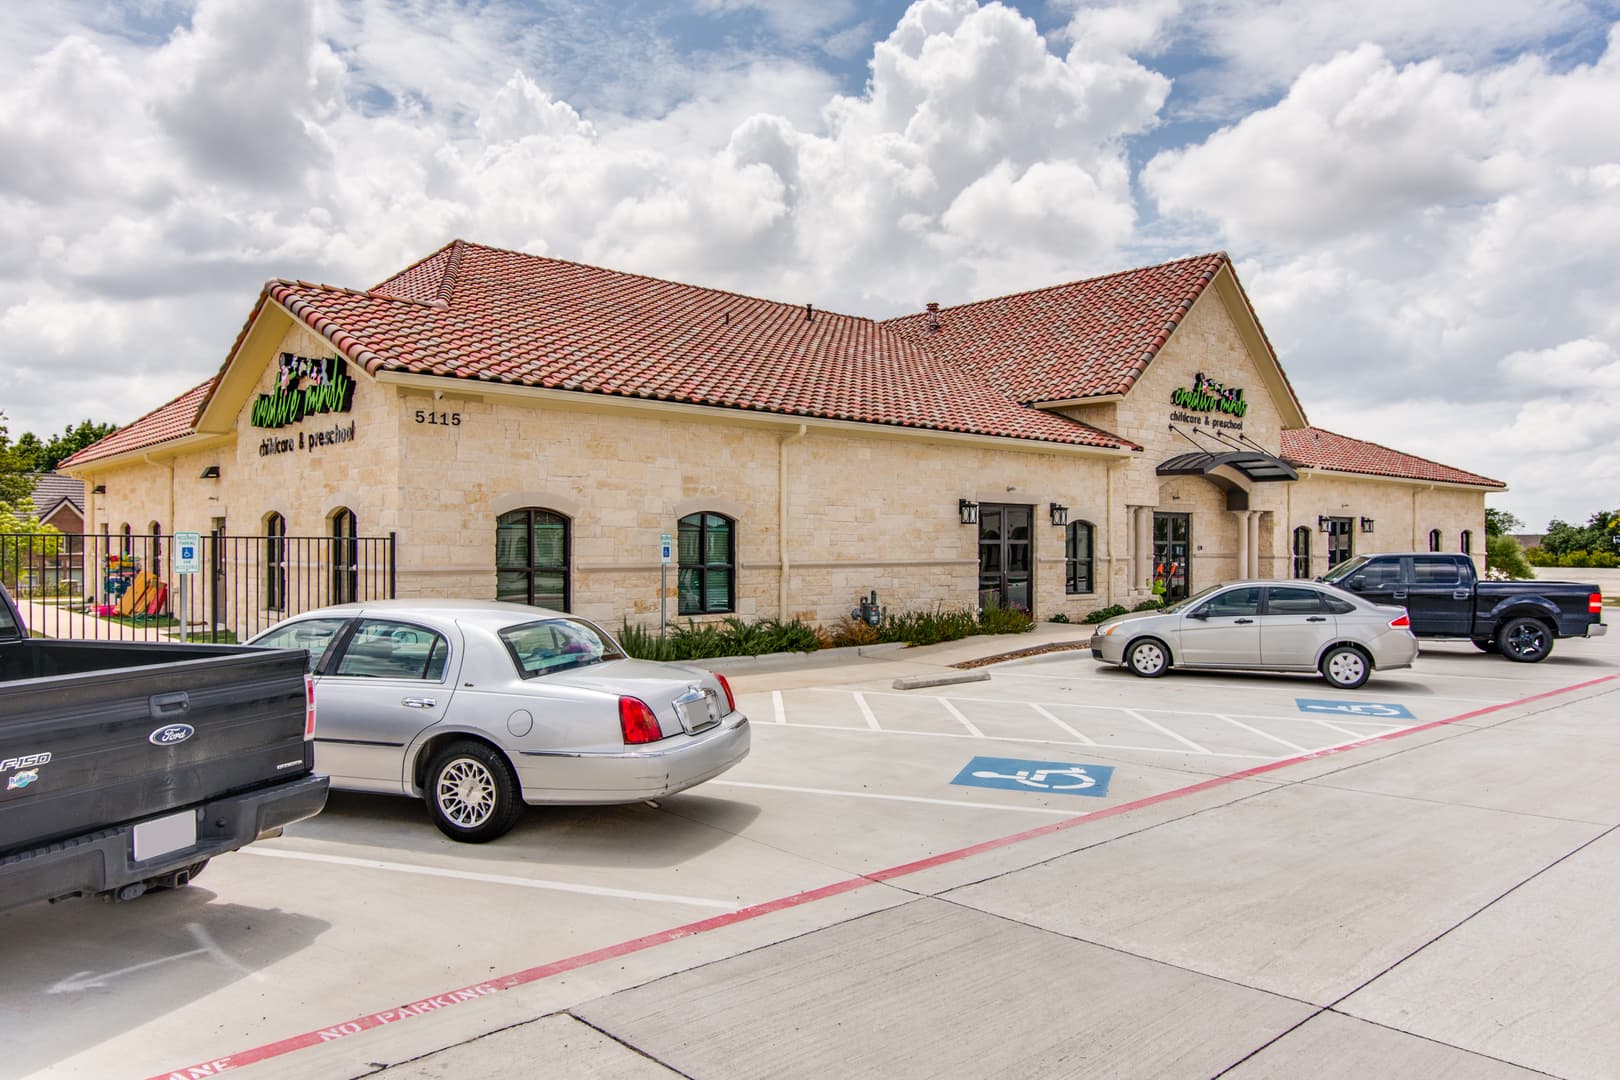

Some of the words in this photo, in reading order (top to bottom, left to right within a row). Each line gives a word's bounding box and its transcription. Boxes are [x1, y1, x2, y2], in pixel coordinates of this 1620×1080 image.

[415, 410, 461, 426] 5115
[1169, 411, 1202, 425] childcare
[1204, 415, 1210, 426] &
[1212, 419, 1243, 431] preschool
[259, 436, 295, 458] childcare
[308, 419, 355, 453] preschool
[161, 727, 187, 742] Ford
[168, 1056, 238, 1080] ANE
[317, 1023, 363, 1042] NO
[375, 983, 498, 1025] PARKING
